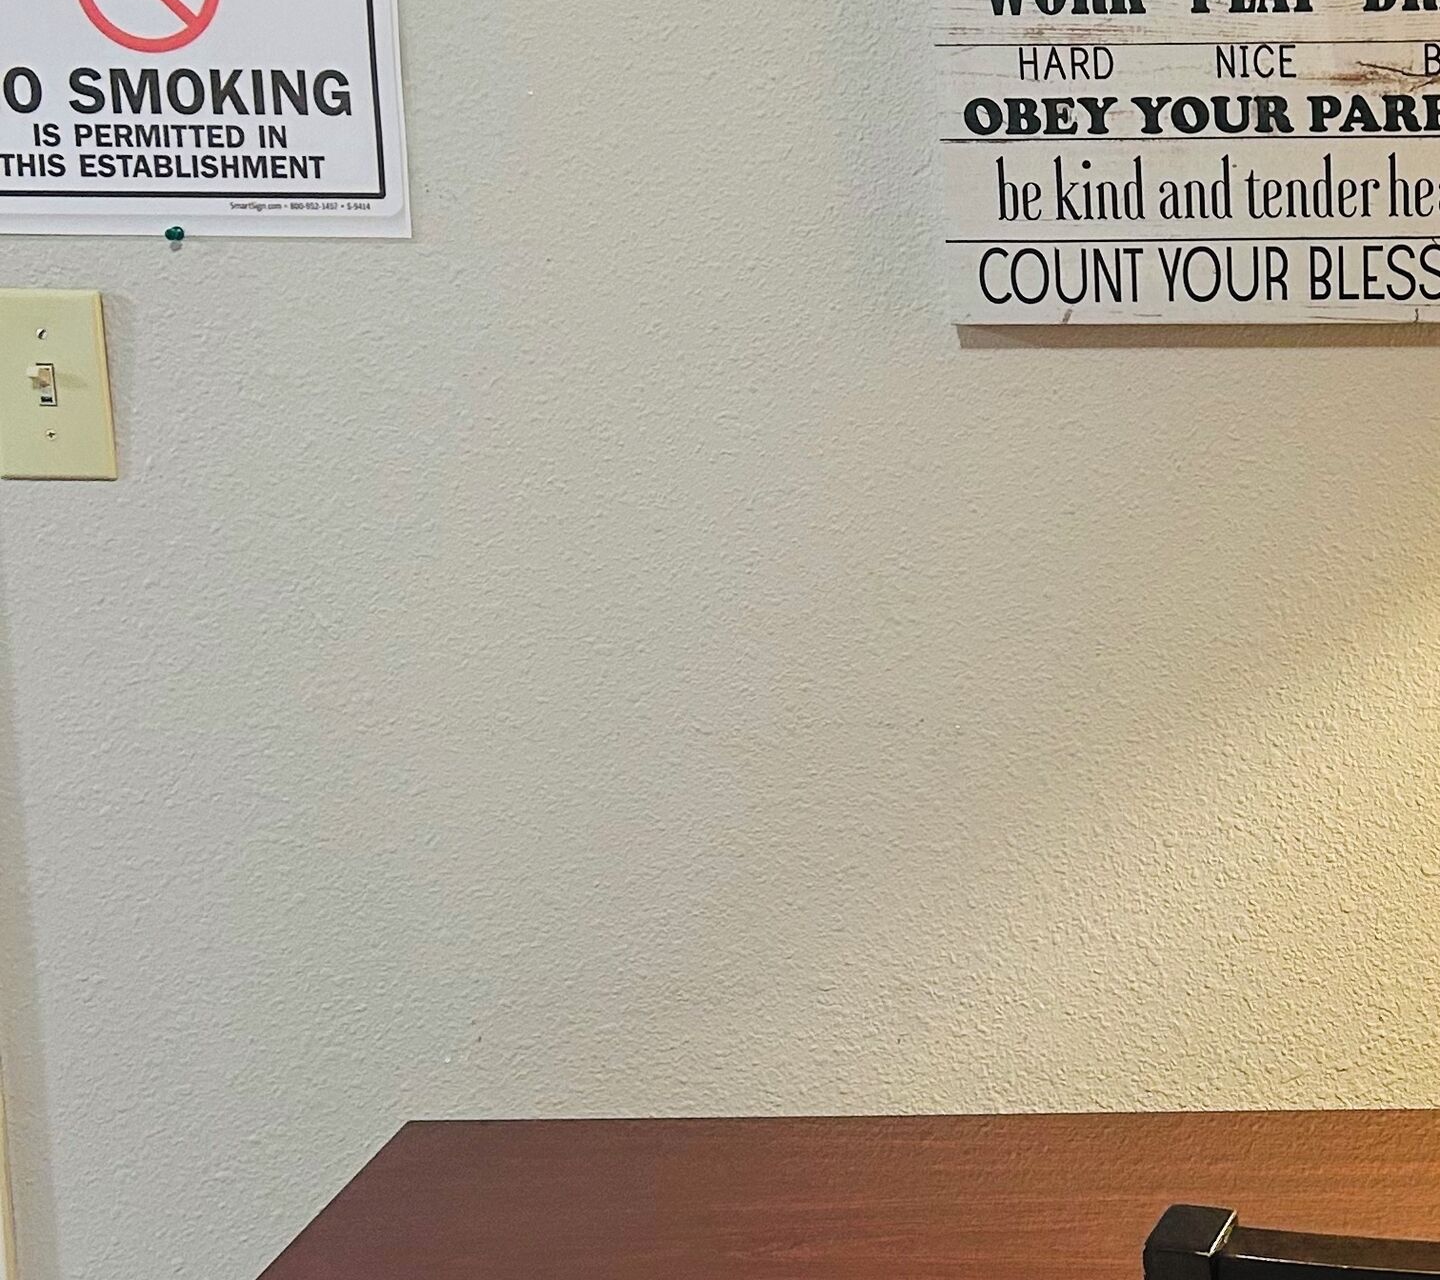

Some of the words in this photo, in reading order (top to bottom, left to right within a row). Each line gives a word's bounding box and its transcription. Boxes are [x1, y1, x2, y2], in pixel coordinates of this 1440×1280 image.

[1018, 46, 1114, 81] HARD
[1216, 44, 1297, 79] NICE
[68, 67, 352, 116] SMOKING
[33, 123, 61, 148] IS
[74, 123, 245, 148] PERMITTED
[259, 125, 288, 149] IN
[963, 96, 1120, 136] OBEY
[1131, 95, 1294, 133] YOUR
[0, 153, 66, 177] THIS
[79, 154, 326, 179] ESTABLISHMENT
[997, 156, 1042, 222] be
[1054, 157, 1145, 220] kind
[1159, 154, 1234, 220] and
[1244, 154, 1381, 219] tender
[978, 247, 1144, 305] COUNT
[1158, 246, 1289, 302] YOUR
